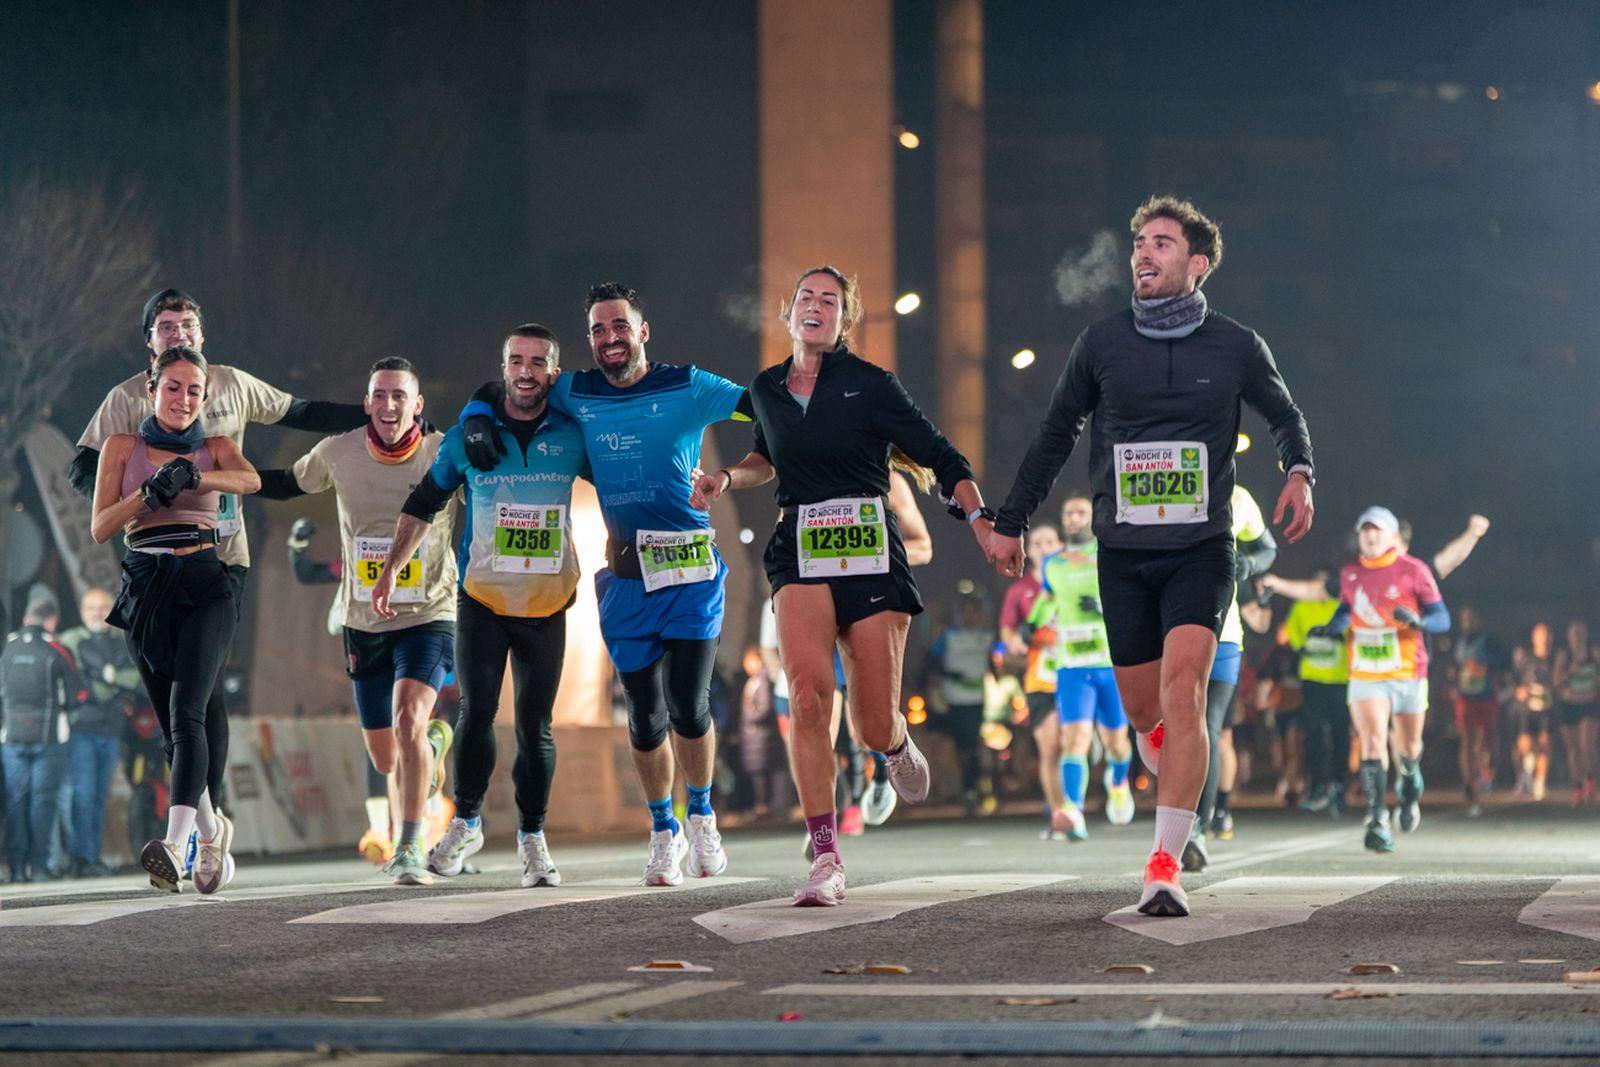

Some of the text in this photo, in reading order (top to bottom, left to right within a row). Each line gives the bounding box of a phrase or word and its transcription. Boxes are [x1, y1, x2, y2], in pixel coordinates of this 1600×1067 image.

[1135, 451, 1173, 461] NOCHE DE
[1125, 462, 1144, 472] SAN
[1145, 460, 1174, 471] ANTÓN
[1127, 471, 1197, 497] 13626
[509, 511, 531, 520] NOCHE
[532, 512, 540, 520] DE
[818, 507, 842, 518] NOCHE
[843, 506, 853, 516] DE
[499, 519, 515, 527] SAN
[516, 519, 540, 528] ANTÓN
[807, 518, 824, 527] SAN
[825, 516, 854, 526] ANTÓN
[505, 528, 550, 550] 7358
[677, 537, 686, 545] DE
[808, 525, 877, 550] 12393
[367, 561, 411, 581] 59
